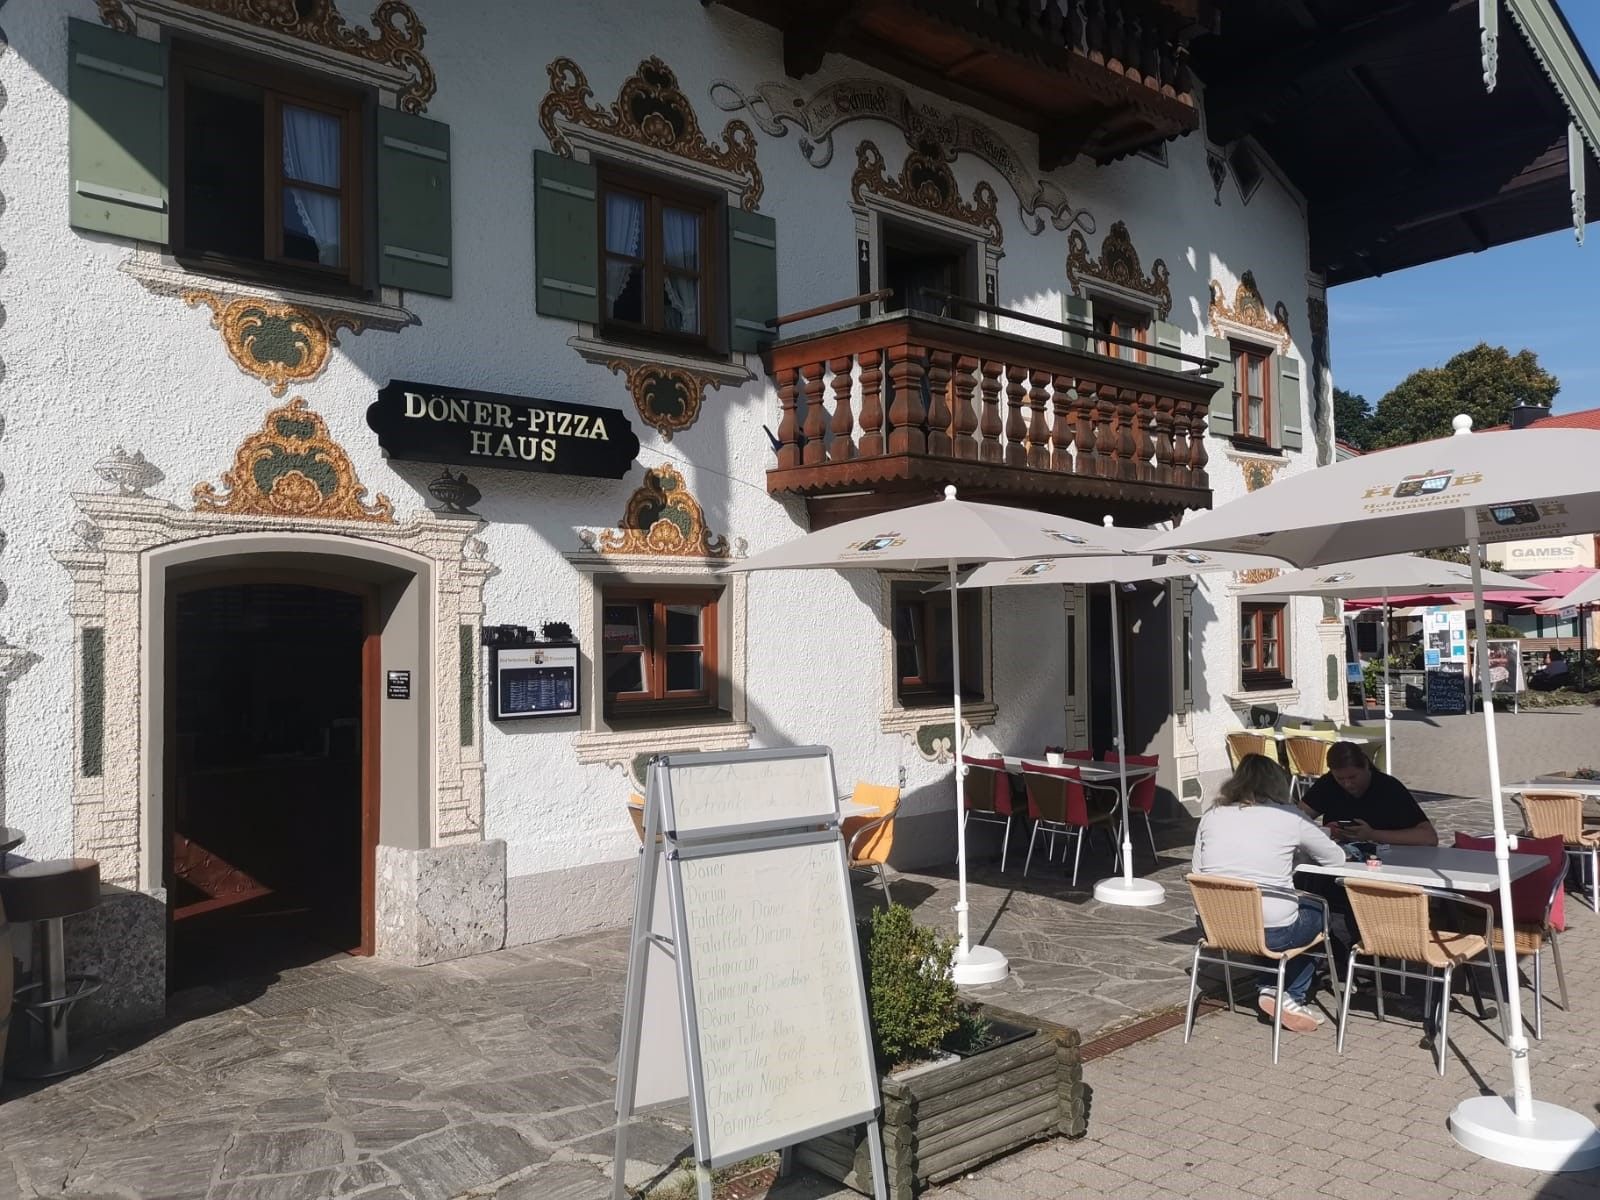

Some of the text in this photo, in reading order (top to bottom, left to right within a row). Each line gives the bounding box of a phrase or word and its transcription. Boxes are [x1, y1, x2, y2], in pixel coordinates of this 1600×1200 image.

[403, 391, 609, 440] DÖNER-PIZZA
[470, 430, 557, 462] HAUS
[1362, 475, 1484, 499] H B
[1511, 546, 1575, 558] GAMBS
